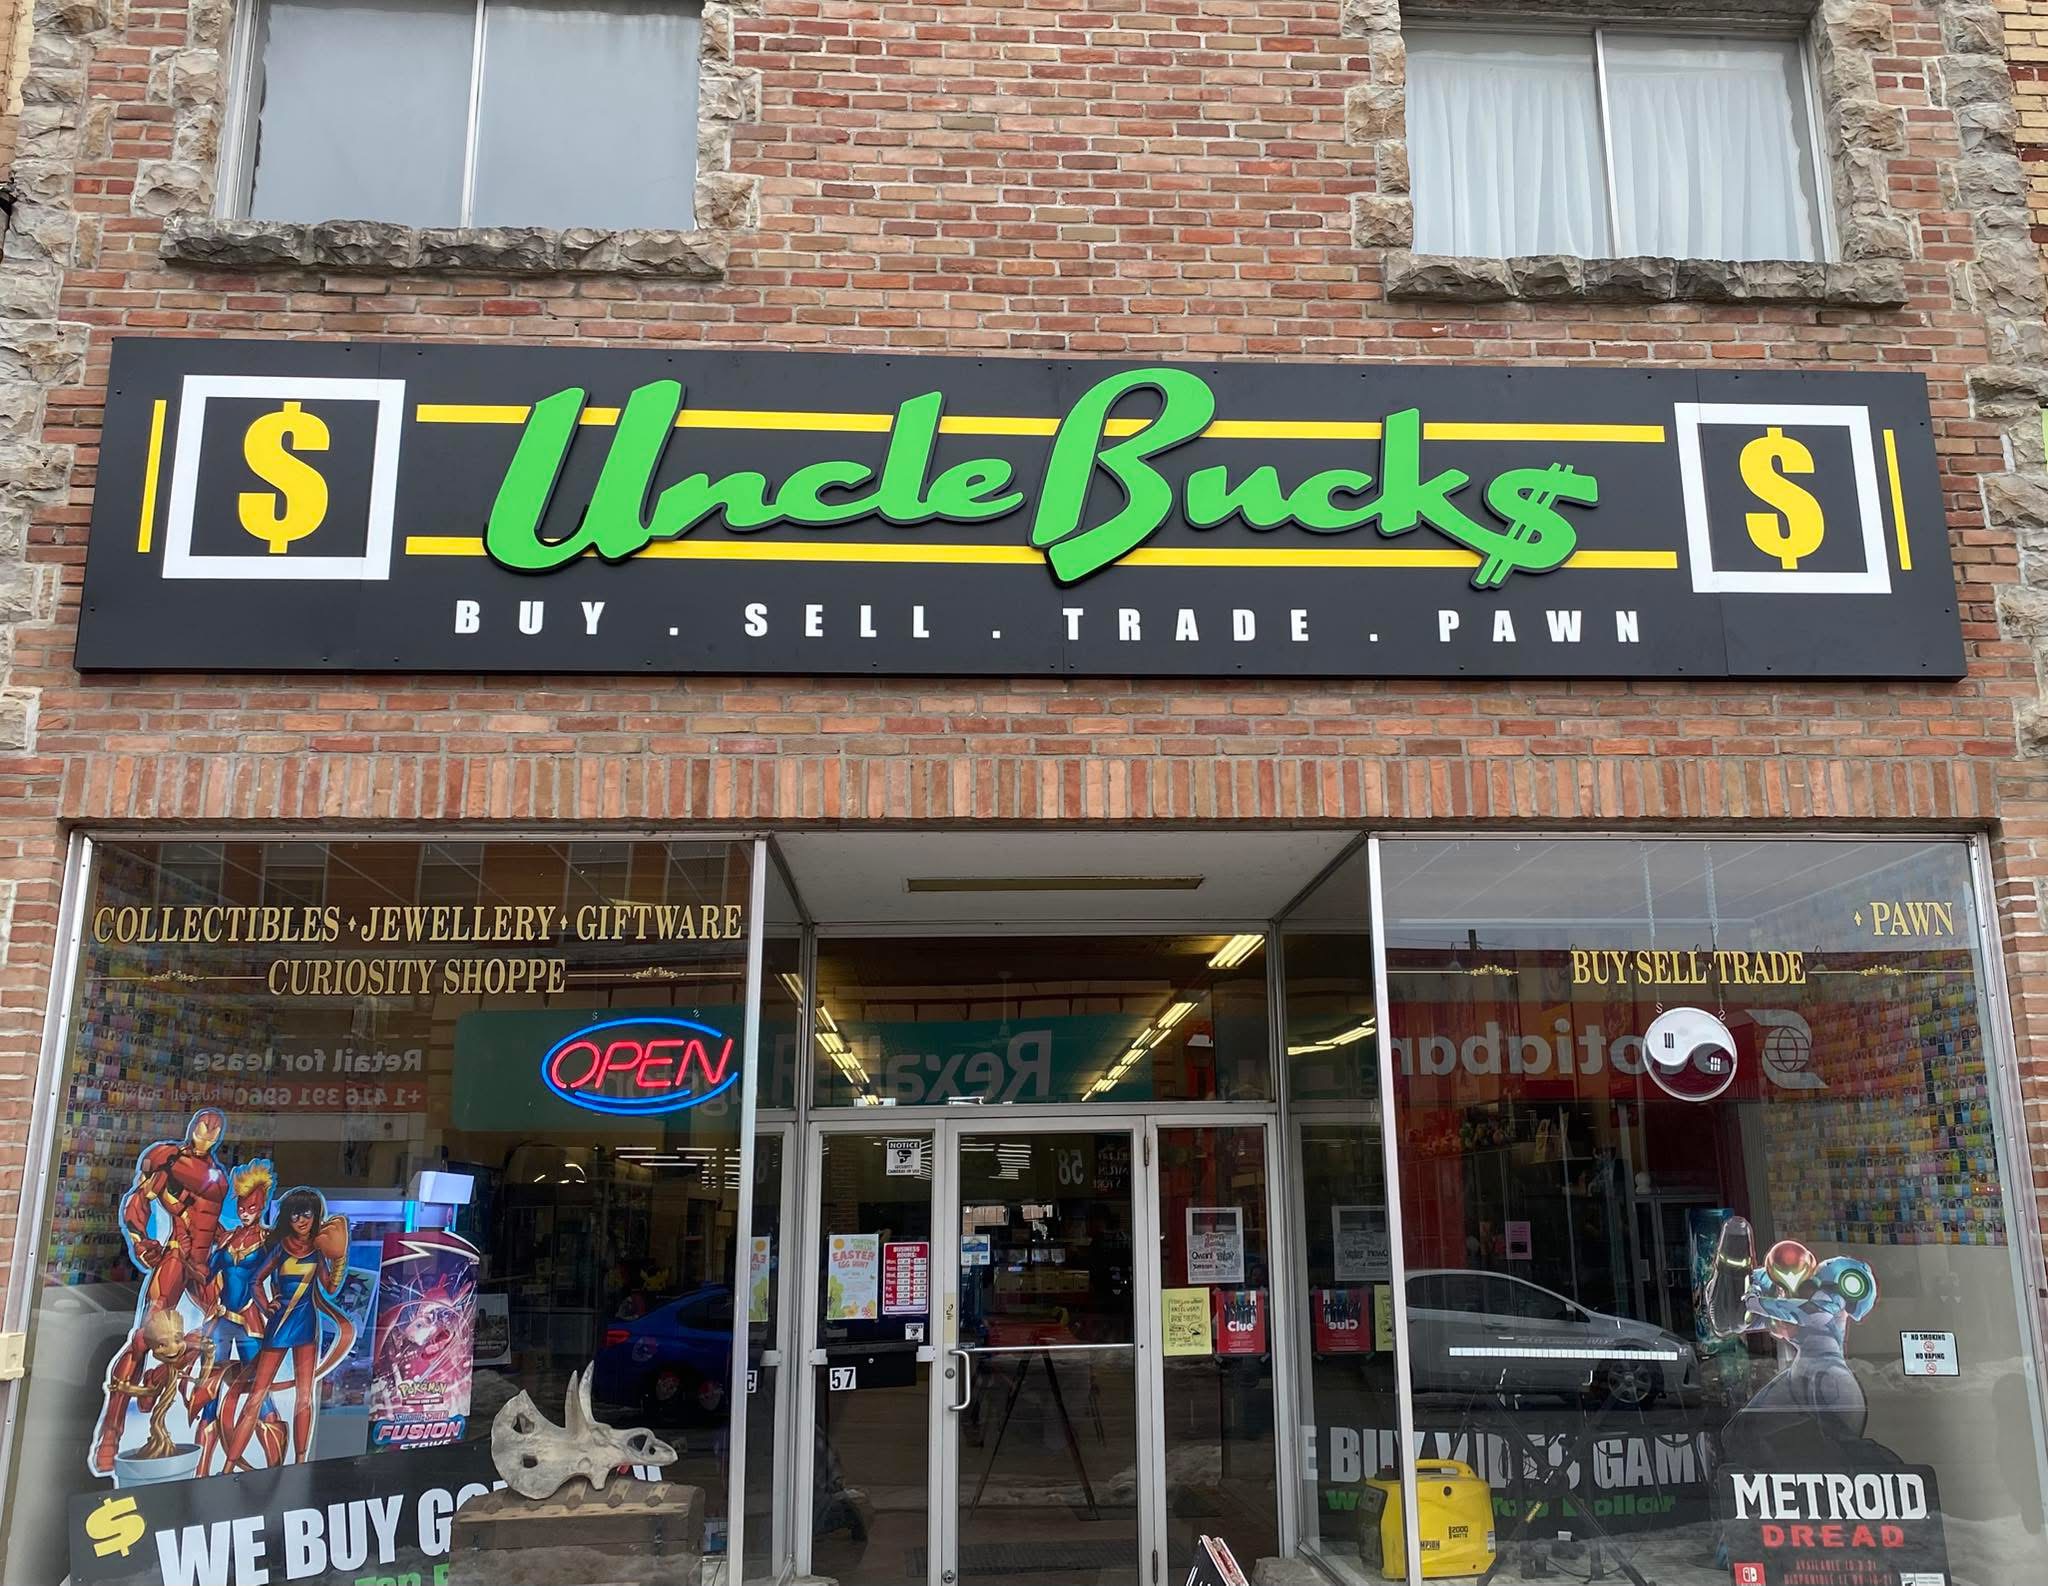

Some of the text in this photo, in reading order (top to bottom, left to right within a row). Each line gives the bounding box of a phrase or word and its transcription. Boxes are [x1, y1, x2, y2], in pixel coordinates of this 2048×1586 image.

[484, 379, 1024, 572] Uncle
[455, 600, 1639, 642] BUY SELL TRADE PAWN
[94, 904, 743, 944] COLLECTIBLES JEWELLERY GIFTWARE
[1871, 902, 1954, 937] PAWN
[267, 958, 566, 996] CURIOSITY SHOPPE
[1572, 950, 1806, 985] BUY SELL TRADE
[551, 1038, 734, 1088] OPEN
[832, 1249, 876, 1262] EASTER
[1228, 1321, 1254, 1332] Clue
[831, 1368, 854, 1388] 57
[378, 1421, 461, 1440] FUSION
[1594, 1431, 1708, 1489] GAM
[1730, 1473, 1928, 1520] METROID
[155, 1516, 269, 1586] WE
[283, 1495, 404, 1580] BUY
[1761, 1524, 1905, 1548] DREAD
